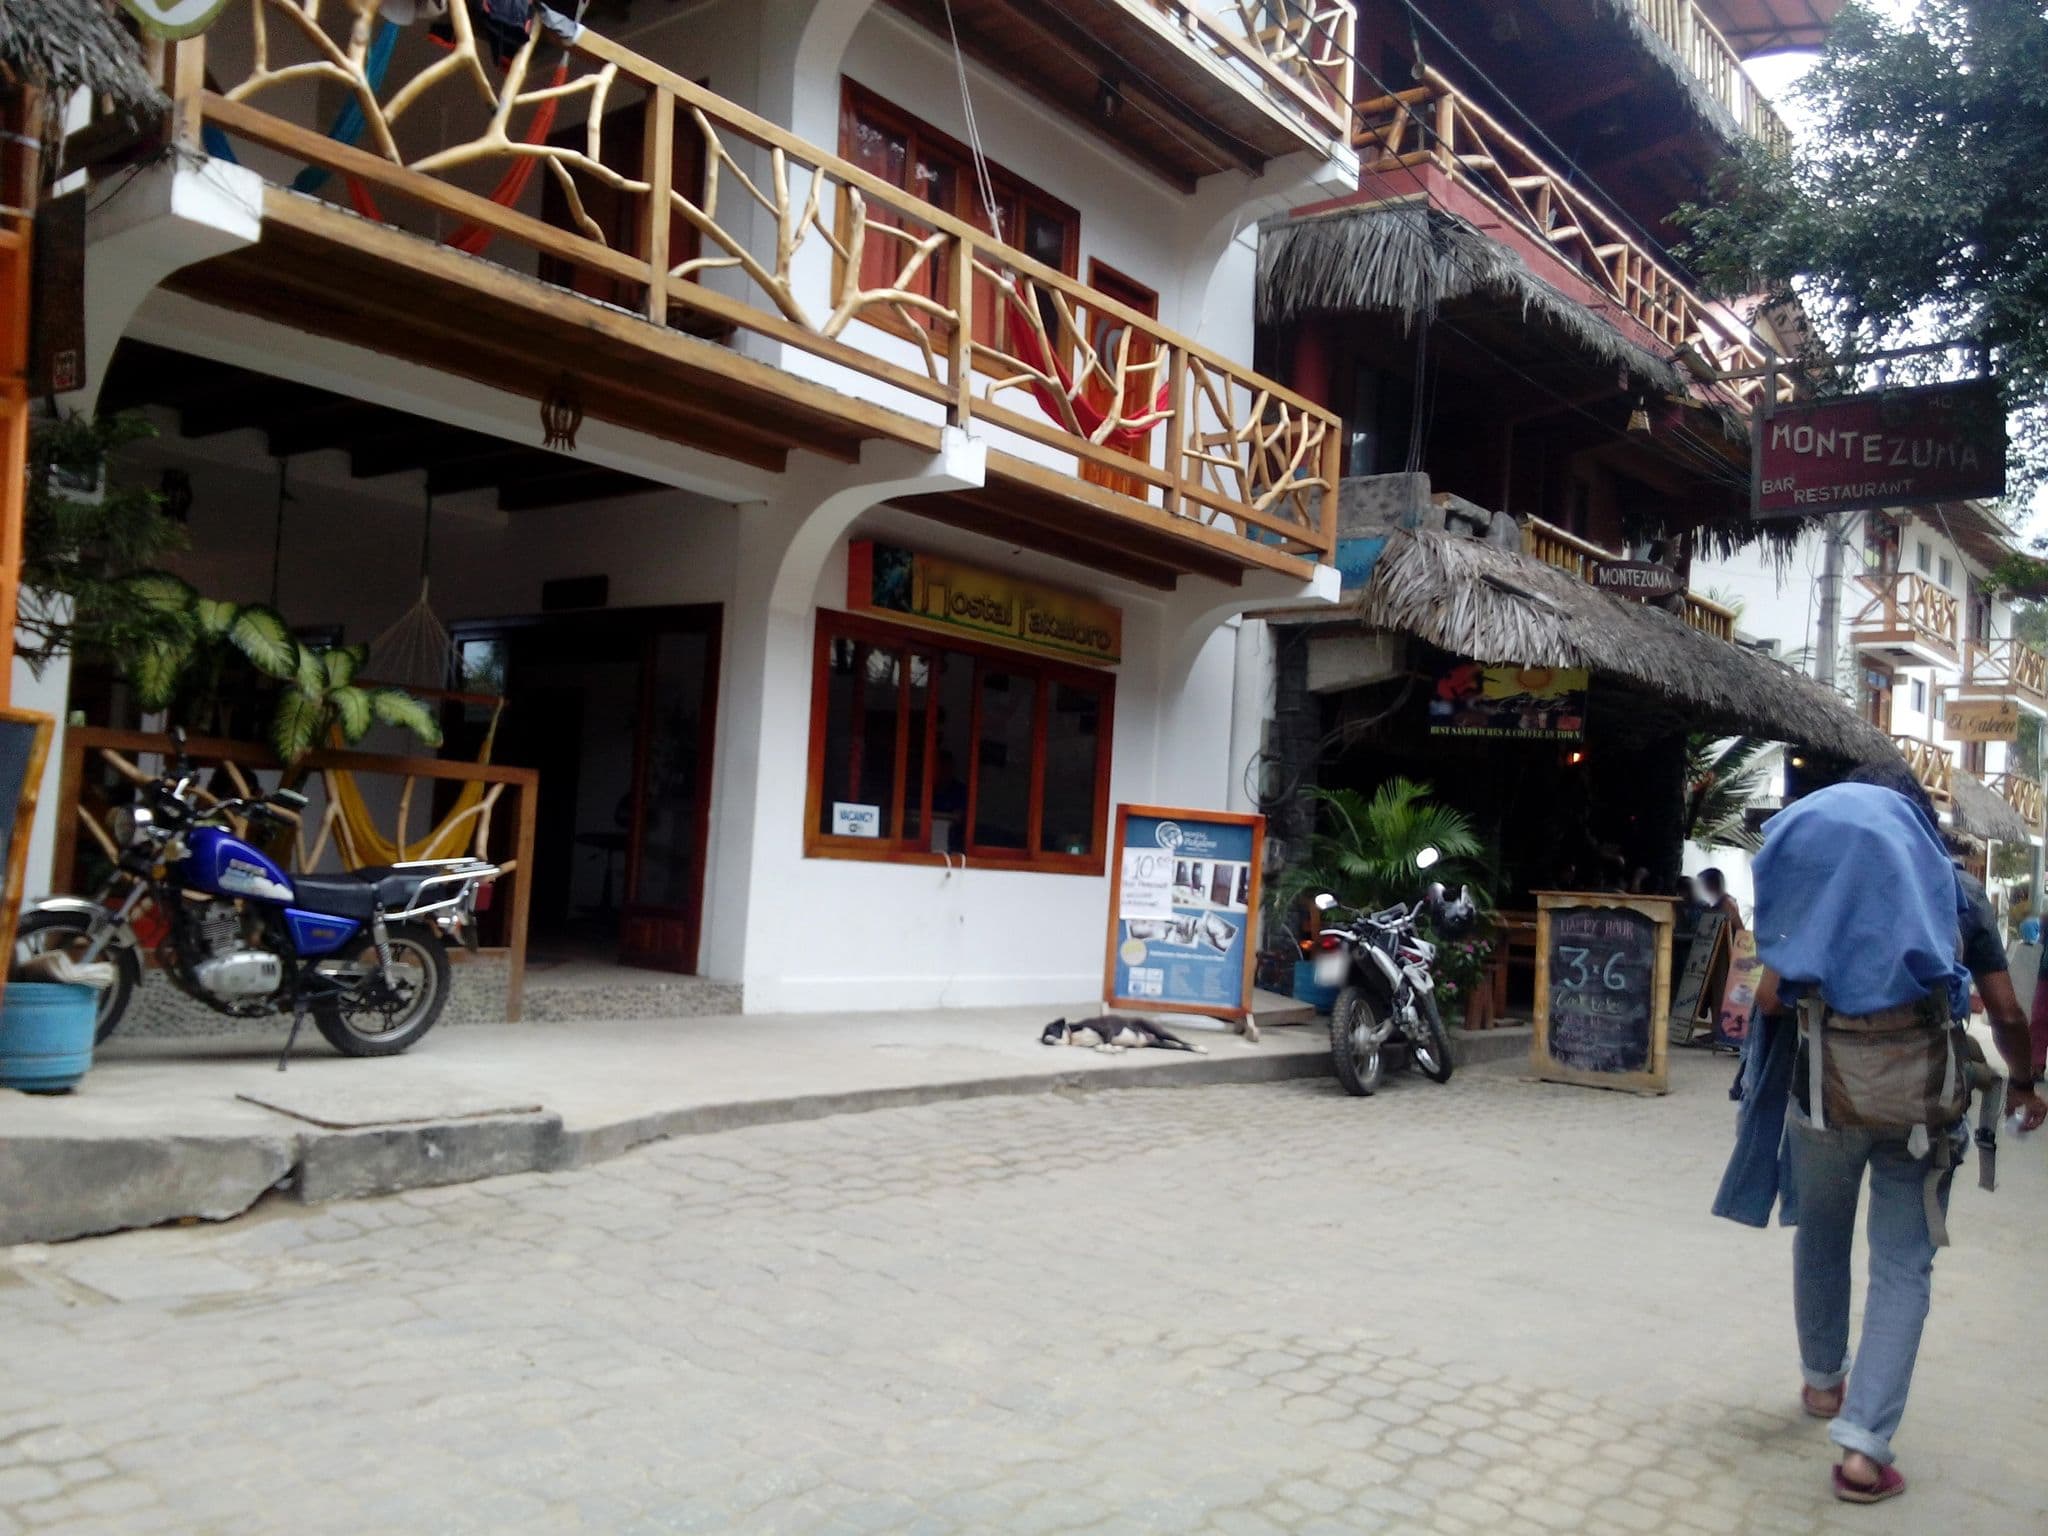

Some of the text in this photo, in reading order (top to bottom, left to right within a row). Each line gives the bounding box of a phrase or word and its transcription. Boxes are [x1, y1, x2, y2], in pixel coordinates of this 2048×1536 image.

[1771, 424, 1979, 472] MONTEZUMA
[1761, 478, 1914, 504] BAR RESTAURANT
[1599, 567, 1672, 589] MONTEZUMA
[922, 570, 1013, 627] Hostal
[1430, 726, 1451, 736] BEST
[1450, 727, 1503, 738] SANDWICHES
[1556, 731, 1581, 740] TOWN
[1605, 920, 1634, 939] HOUR
